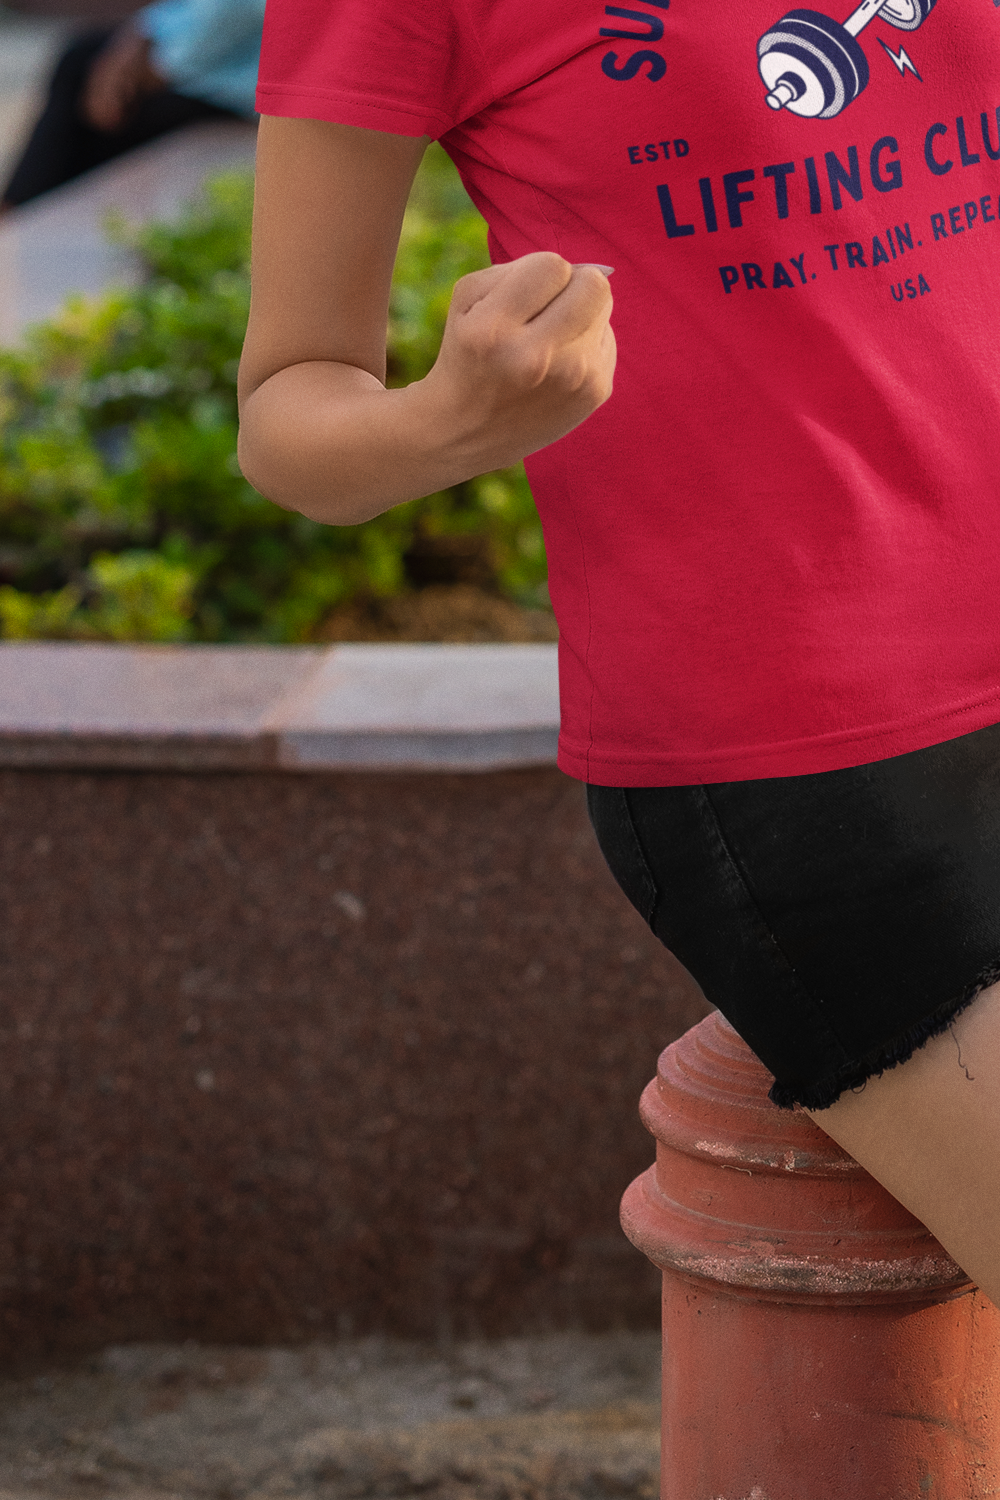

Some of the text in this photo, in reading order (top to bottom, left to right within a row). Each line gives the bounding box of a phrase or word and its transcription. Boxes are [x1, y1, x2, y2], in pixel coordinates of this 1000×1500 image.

[628, 138, 690, 165] ESTD
[657, 136, 903, 239] LIFTING
[718, 253, 817, 294] PRAY.
[824, 224, 923, 272] TRAIN.
[890, 273, 932, 303] USA
